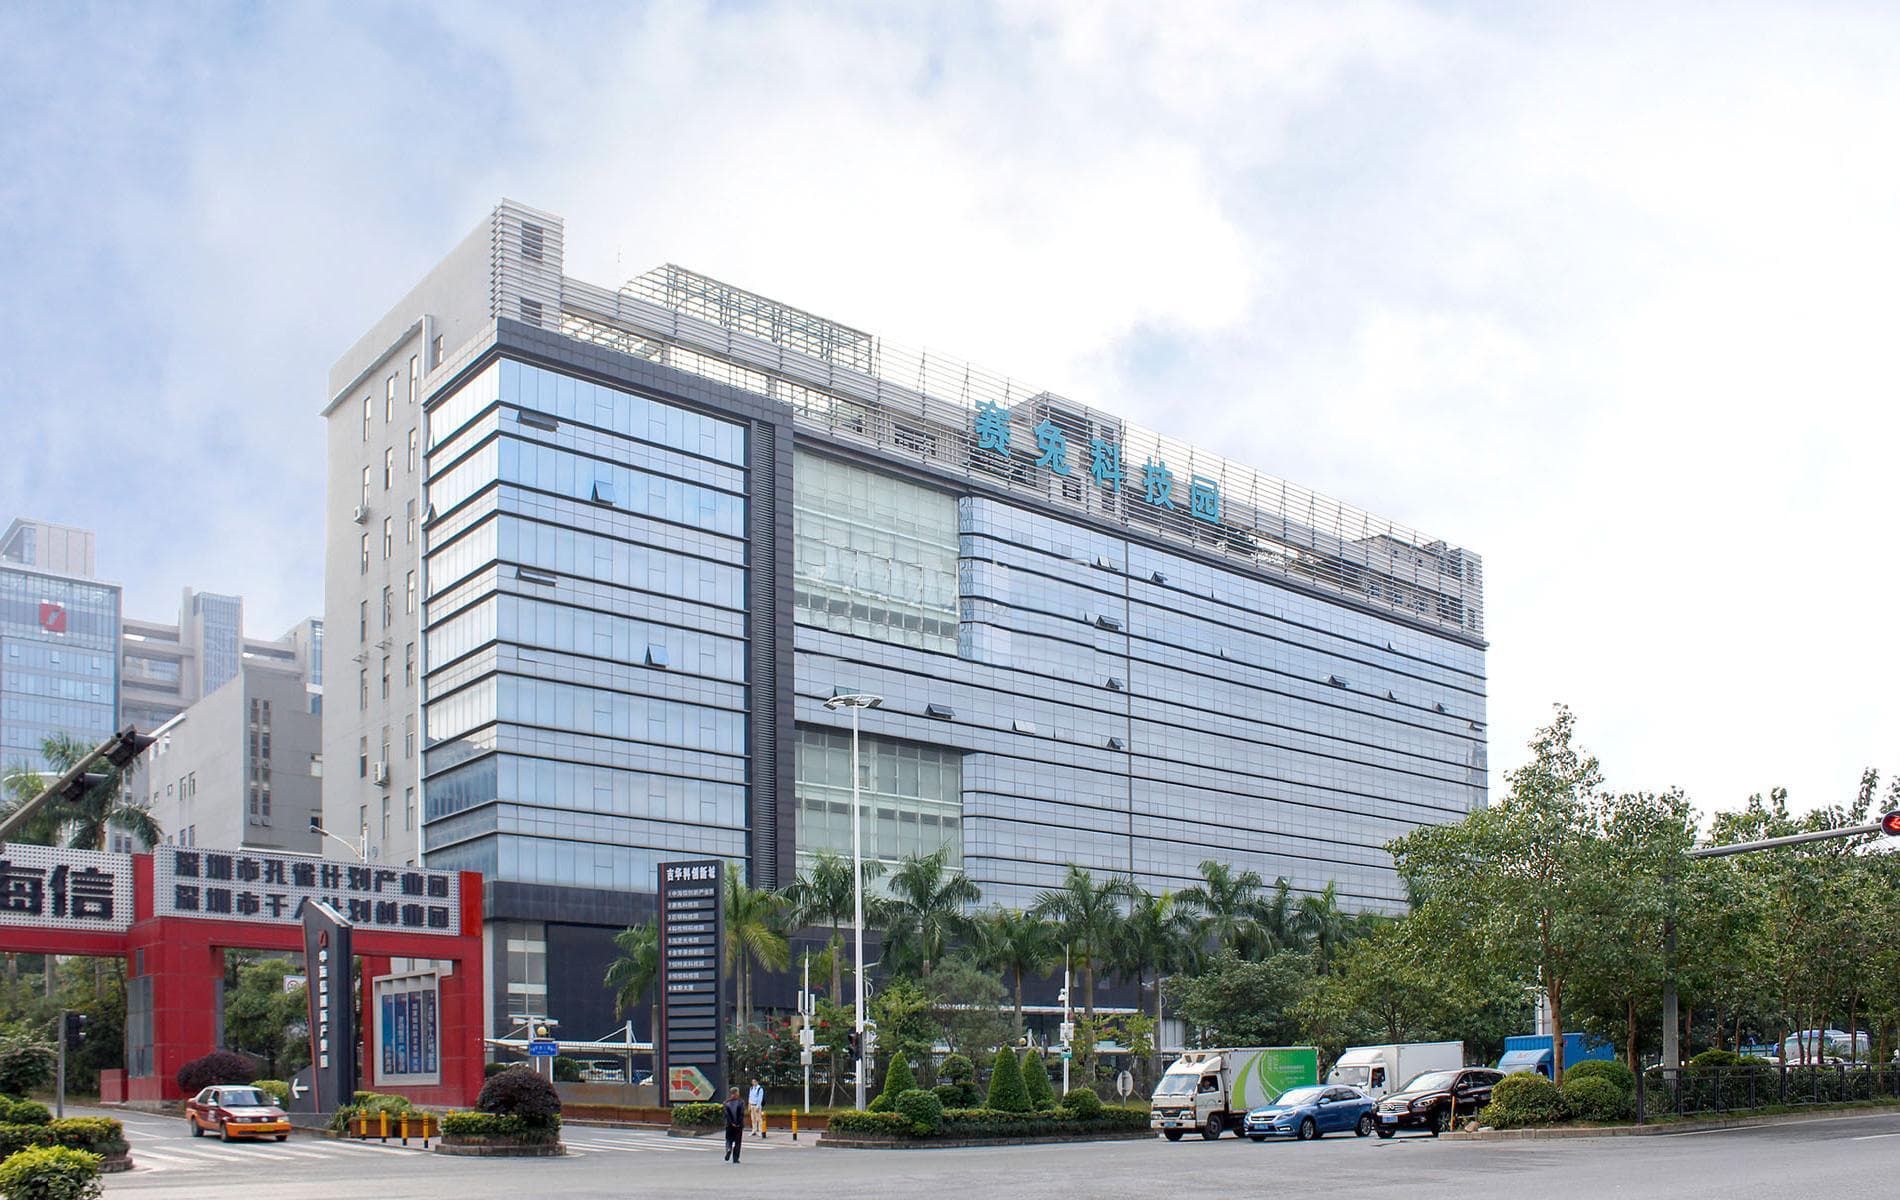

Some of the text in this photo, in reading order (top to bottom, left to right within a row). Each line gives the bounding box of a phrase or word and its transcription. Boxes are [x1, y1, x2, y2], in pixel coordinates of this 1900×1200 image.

[175, 851, 449, 897] 深圳市孔雀计划产业园
